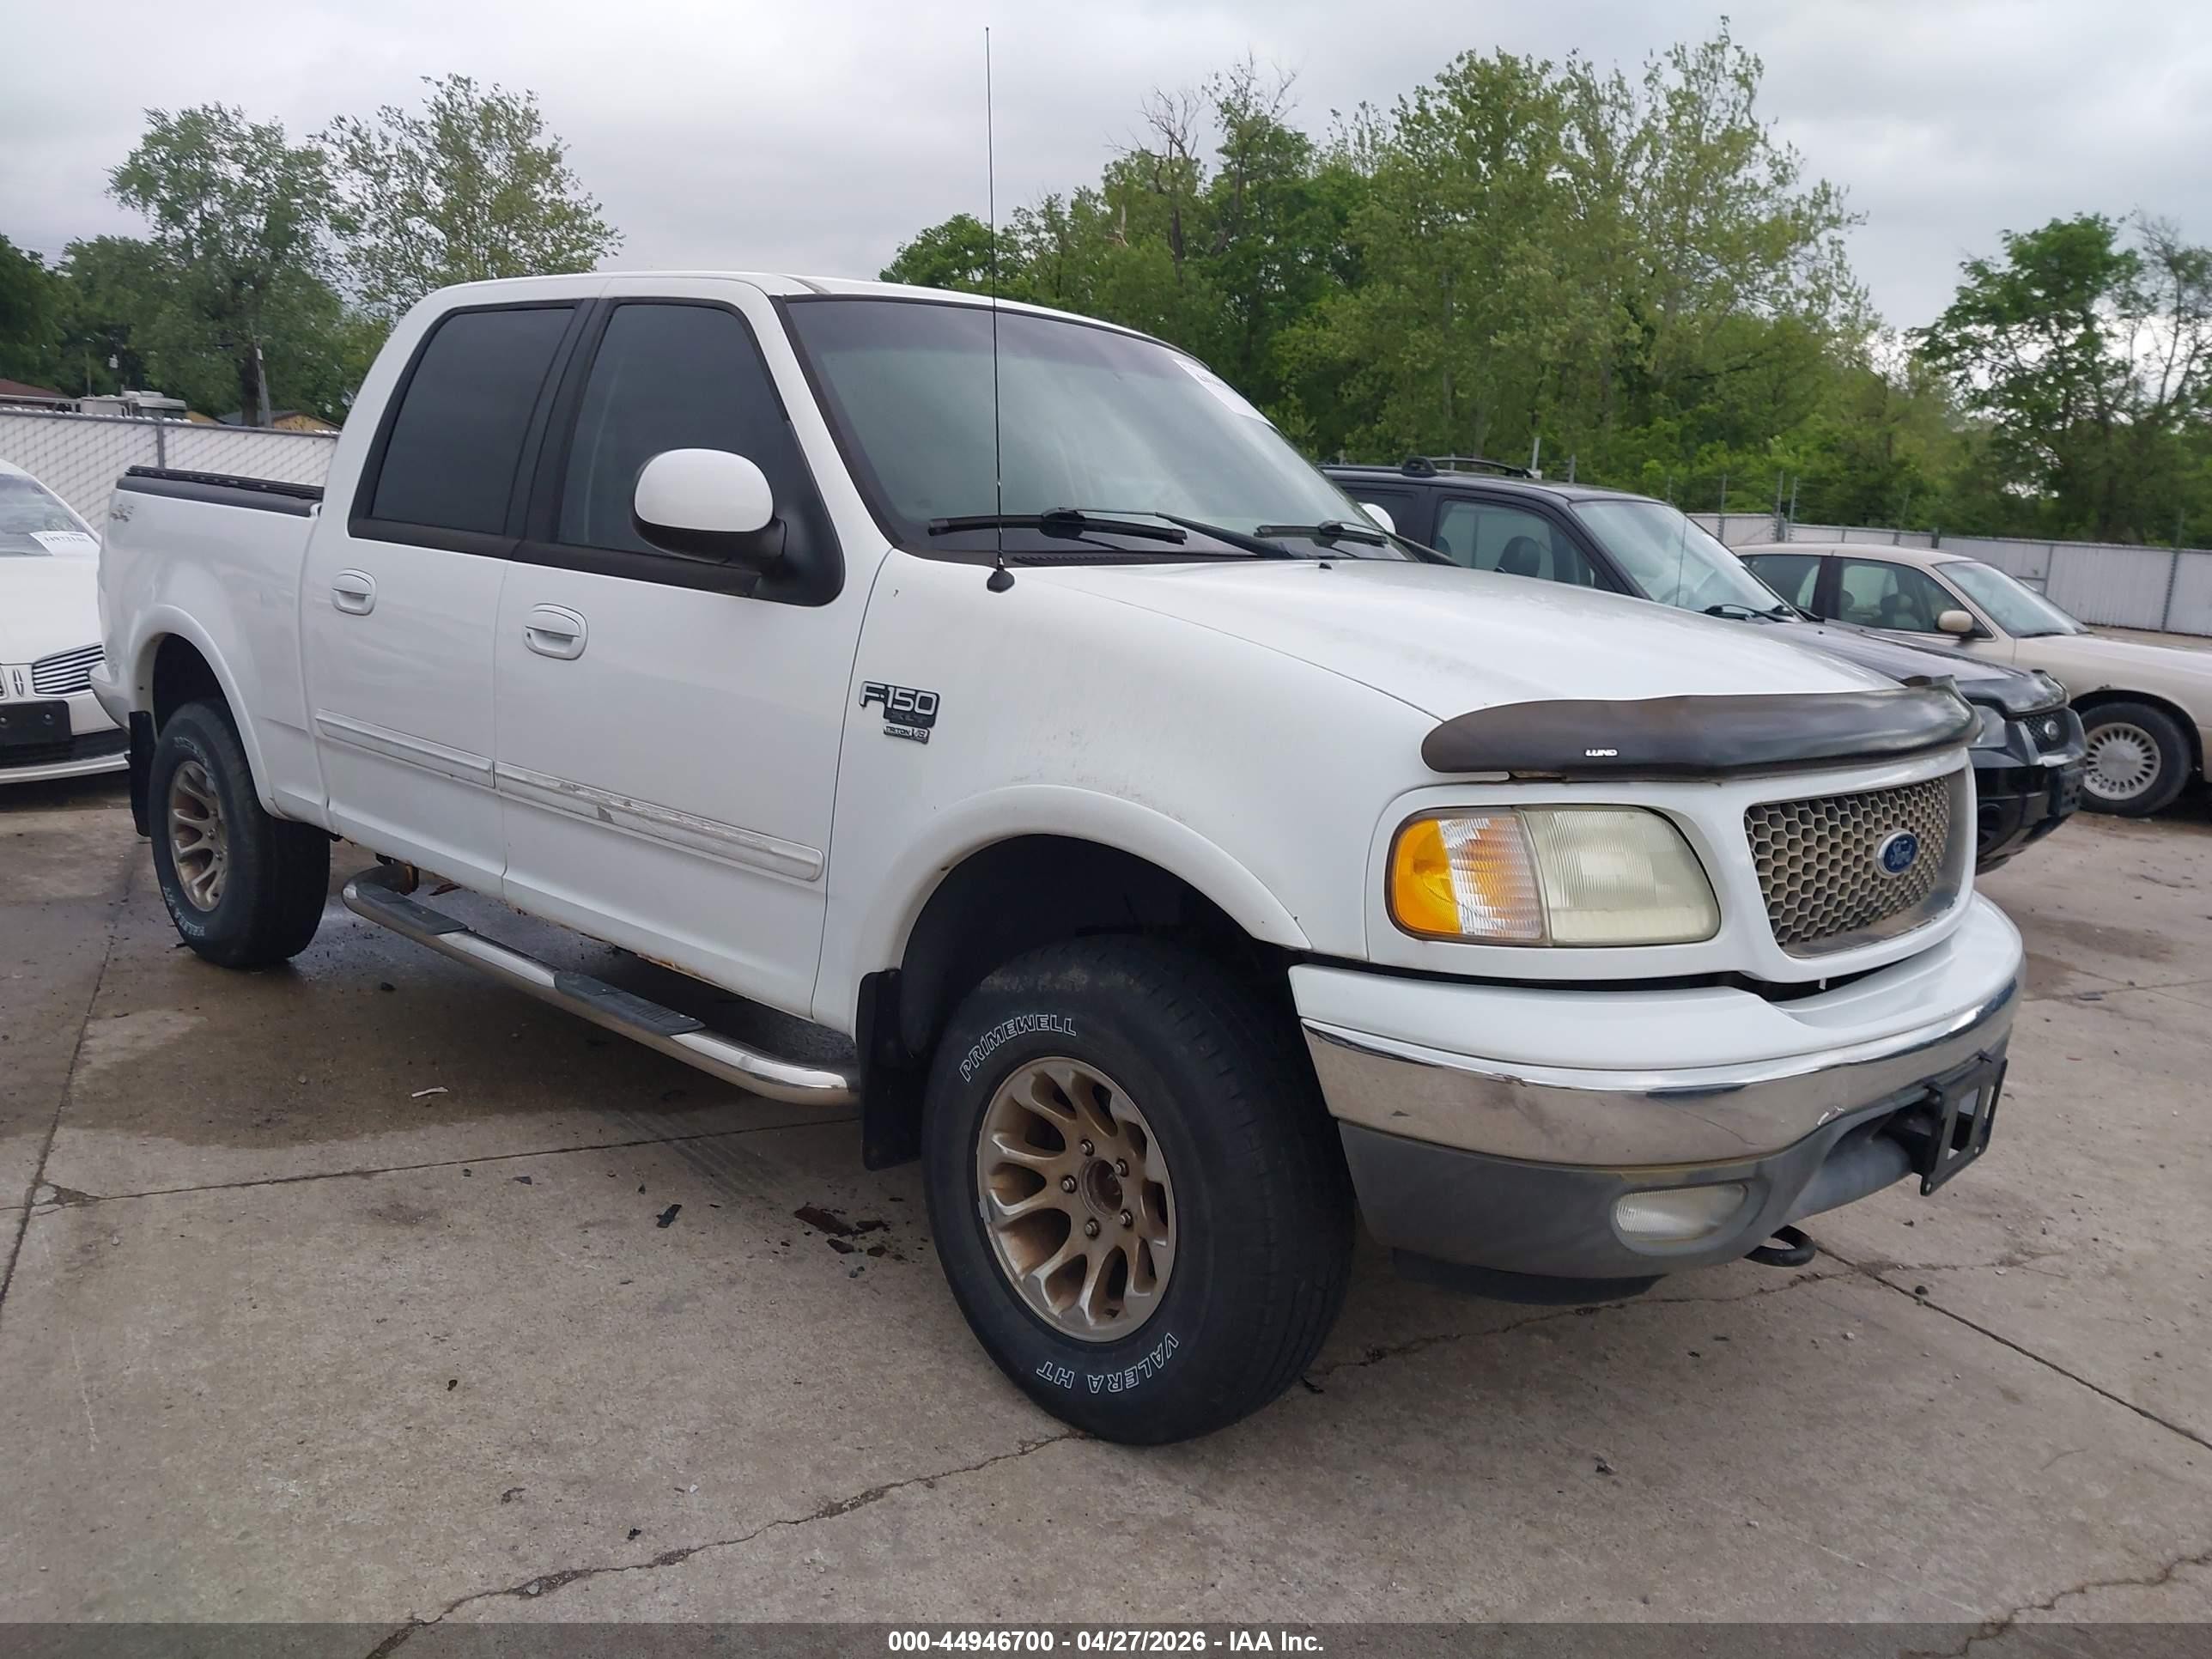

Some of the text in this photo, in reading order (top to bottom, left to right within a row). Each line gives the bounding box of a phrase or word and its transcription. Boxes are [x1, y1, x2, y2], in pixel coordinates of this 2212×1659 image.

[959, 1014, 1077, 1084] PRIMEWELL
[1036, 1332, 1180, 1395] VALERA HT
